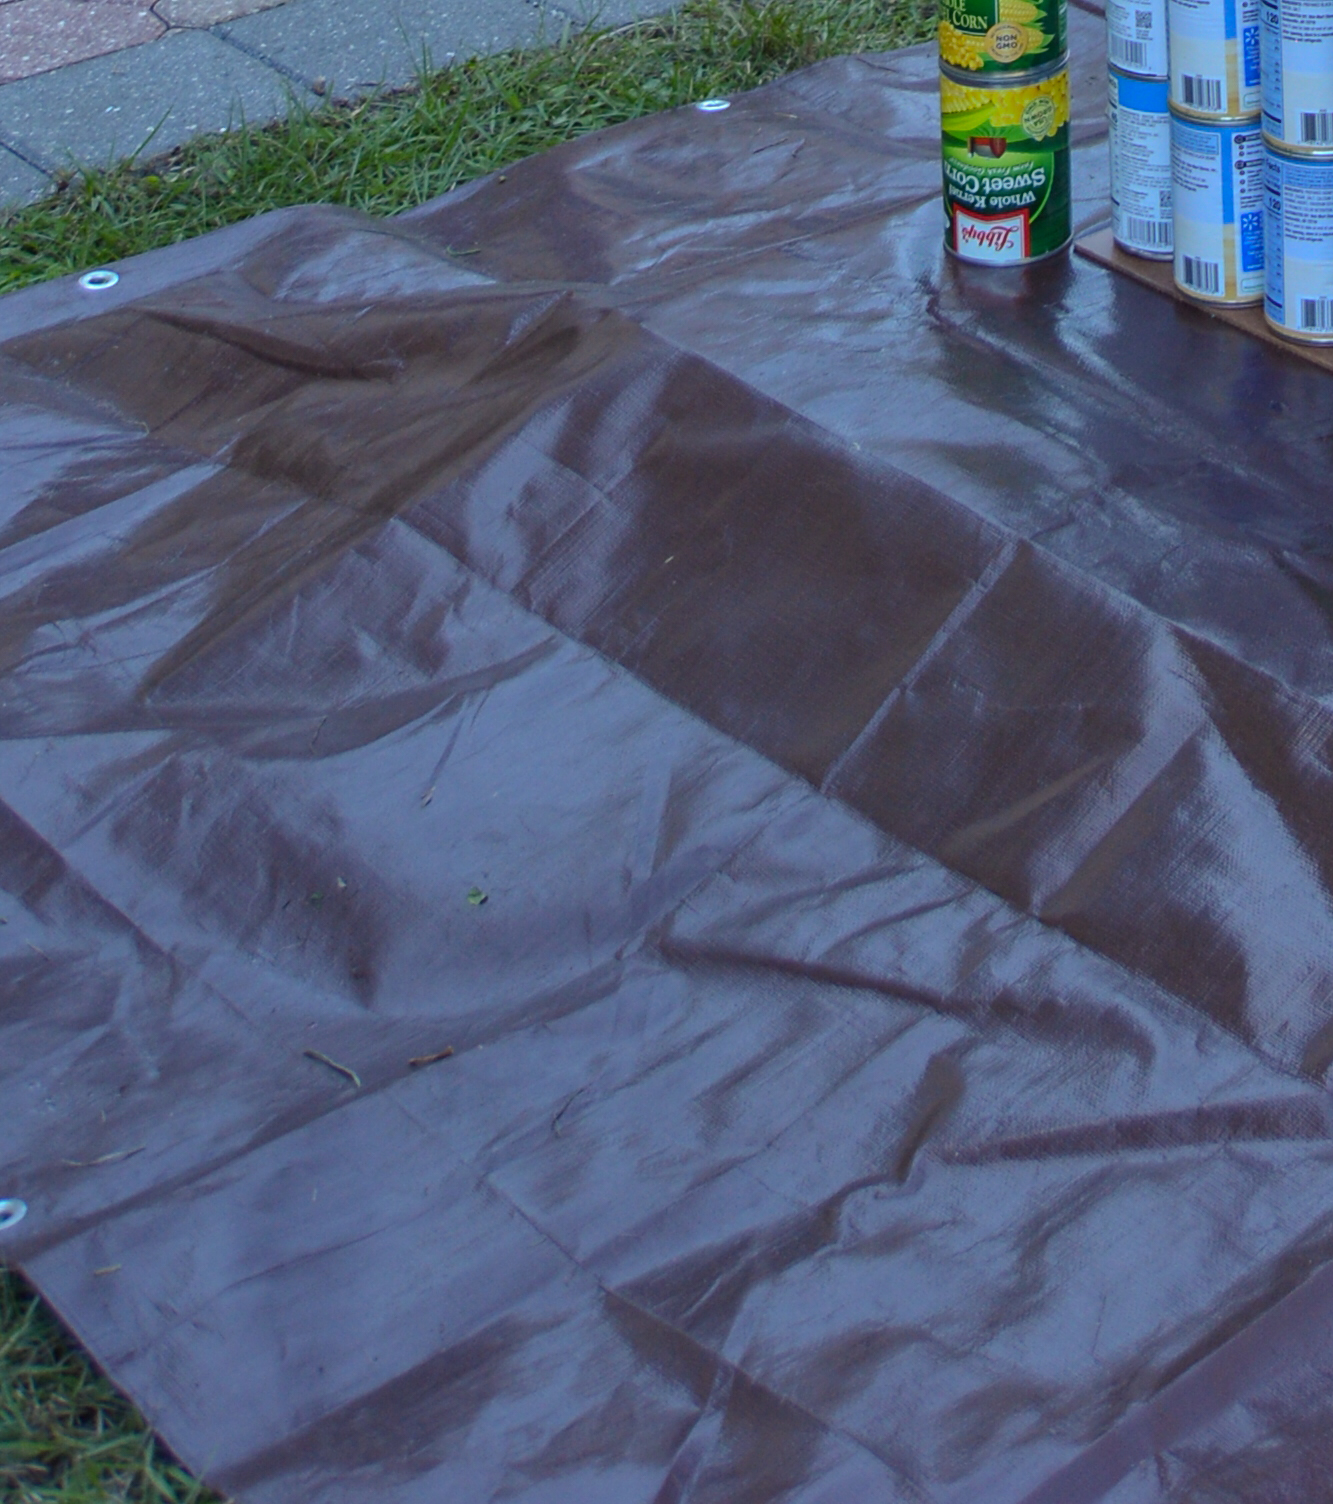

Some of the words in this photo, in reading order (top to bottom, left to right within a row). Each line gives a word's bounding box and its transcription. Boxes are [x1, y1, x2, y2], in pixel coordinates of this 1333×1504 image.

[952, 10, 988, 29] CORN
[945, 160, 979, 193] Corn
[983, 167, 1046, 191] Sweet
[990, 190, 1036, 206] Whole
[962, 224, 1019, 251] Libby's
